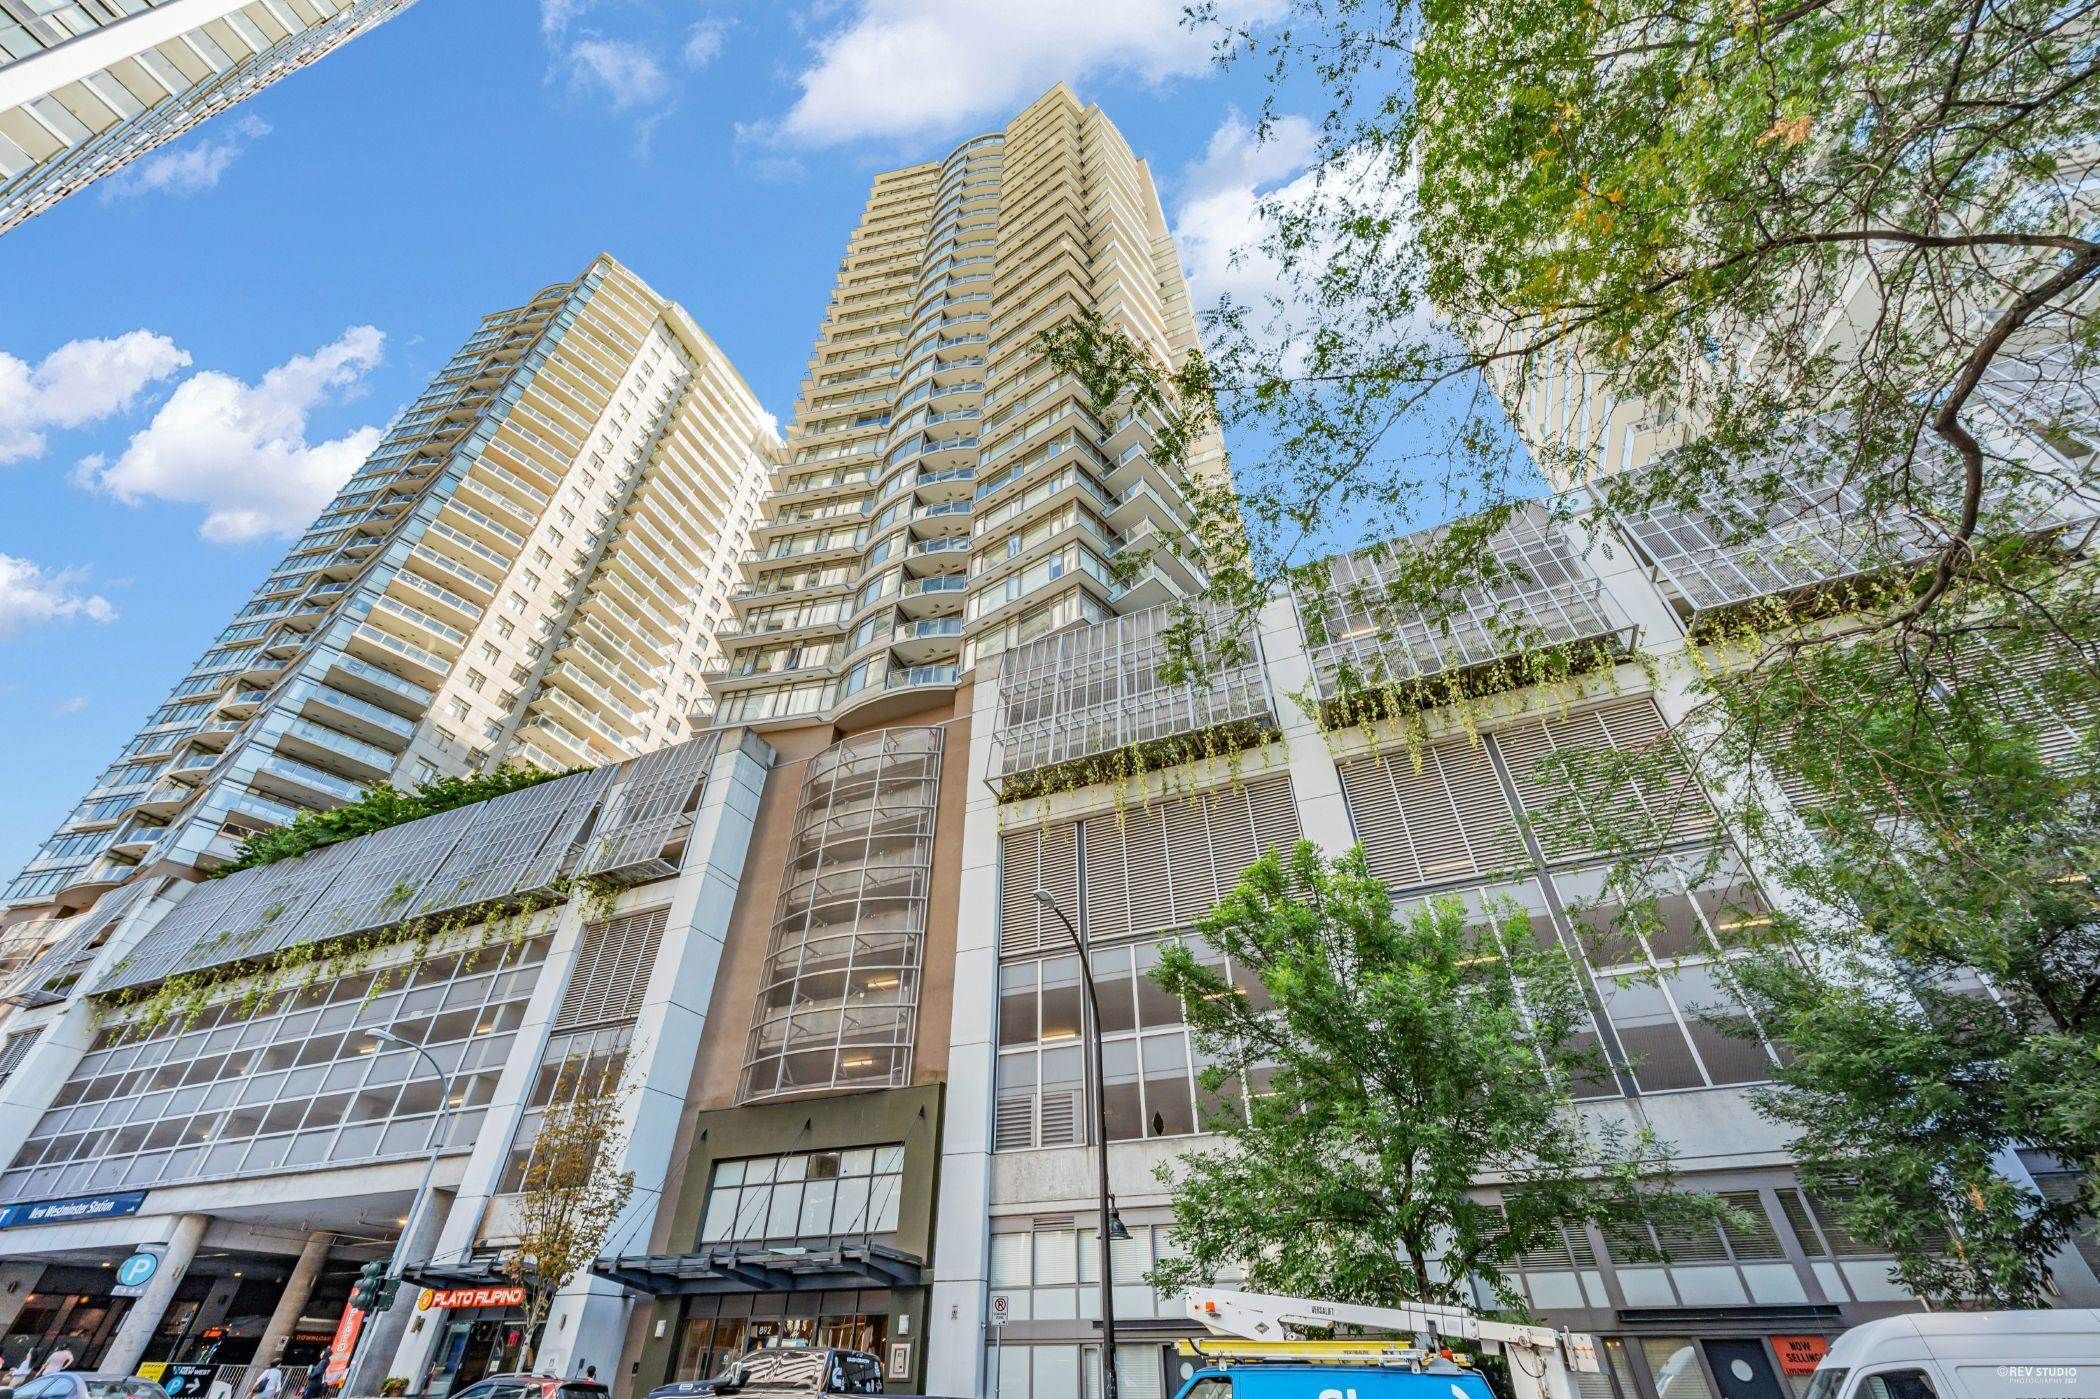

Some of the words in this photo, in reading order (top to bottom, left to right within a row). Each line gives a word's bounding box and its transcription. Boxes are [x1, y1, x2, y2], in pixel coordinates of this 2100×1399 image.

[28, 1207, 47, 1219] New
[45, 1203, 90, 1218] Westminster
[87, 1200, 115, 1215] Station
[127, 1258, 151, 1281] P
[433, 1291, 474, 1306] PLATO
[473, 1289, 522, 1304] FILIPINO
[1311, 1305, 1334, 1315] VERSALIFT
[759, 1326, 772, 1335] 892
[1789, 1341, 1812, 1351] NOW
[1785, 1353, 1823, 1363] SELLING!
